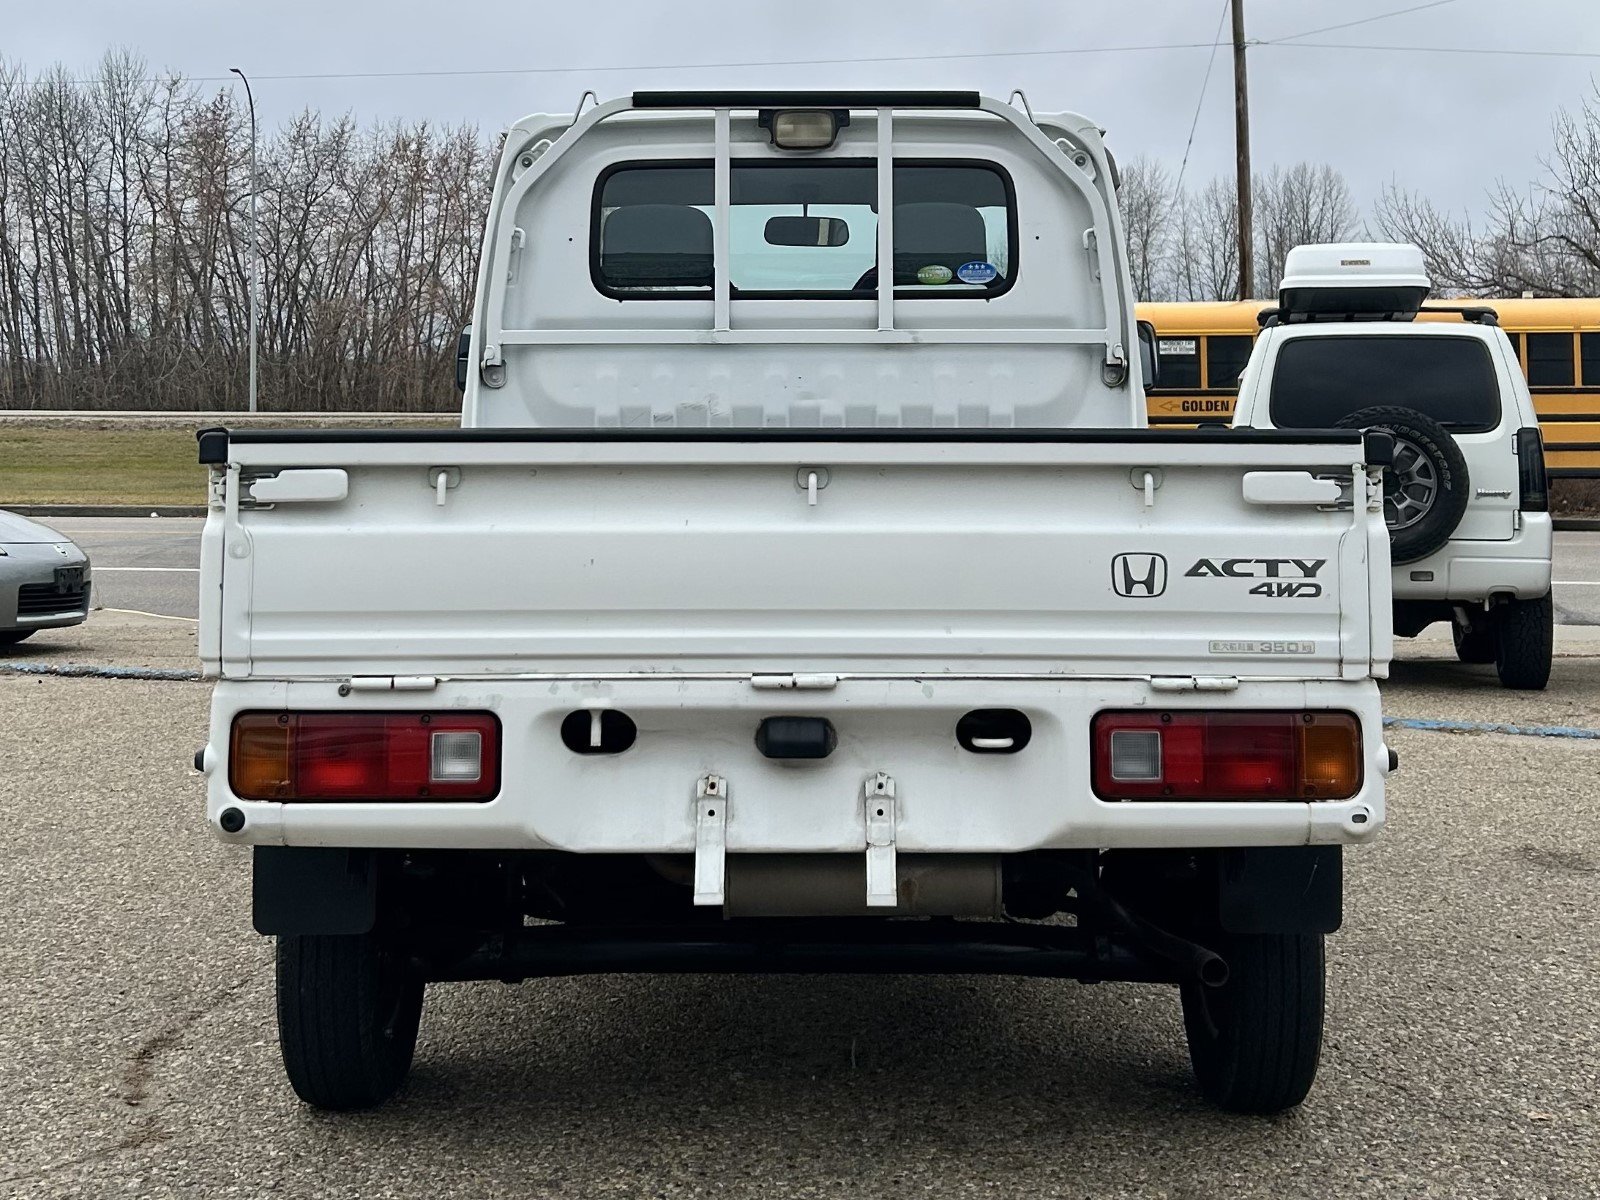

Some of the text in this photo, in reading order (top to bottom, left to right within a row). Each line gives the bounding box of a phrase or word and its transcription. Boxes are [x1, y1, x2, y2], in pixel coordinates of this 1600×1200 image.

[1181, 399, 1230, 412] GOLDEN
[1377, 423, 1452, 491] RIDGESTONE
[1184, 558, 1328, 578] ACTY
[1249, 581, 1322, 598] 4WD
[1260, 641, 1299, 653] 350
